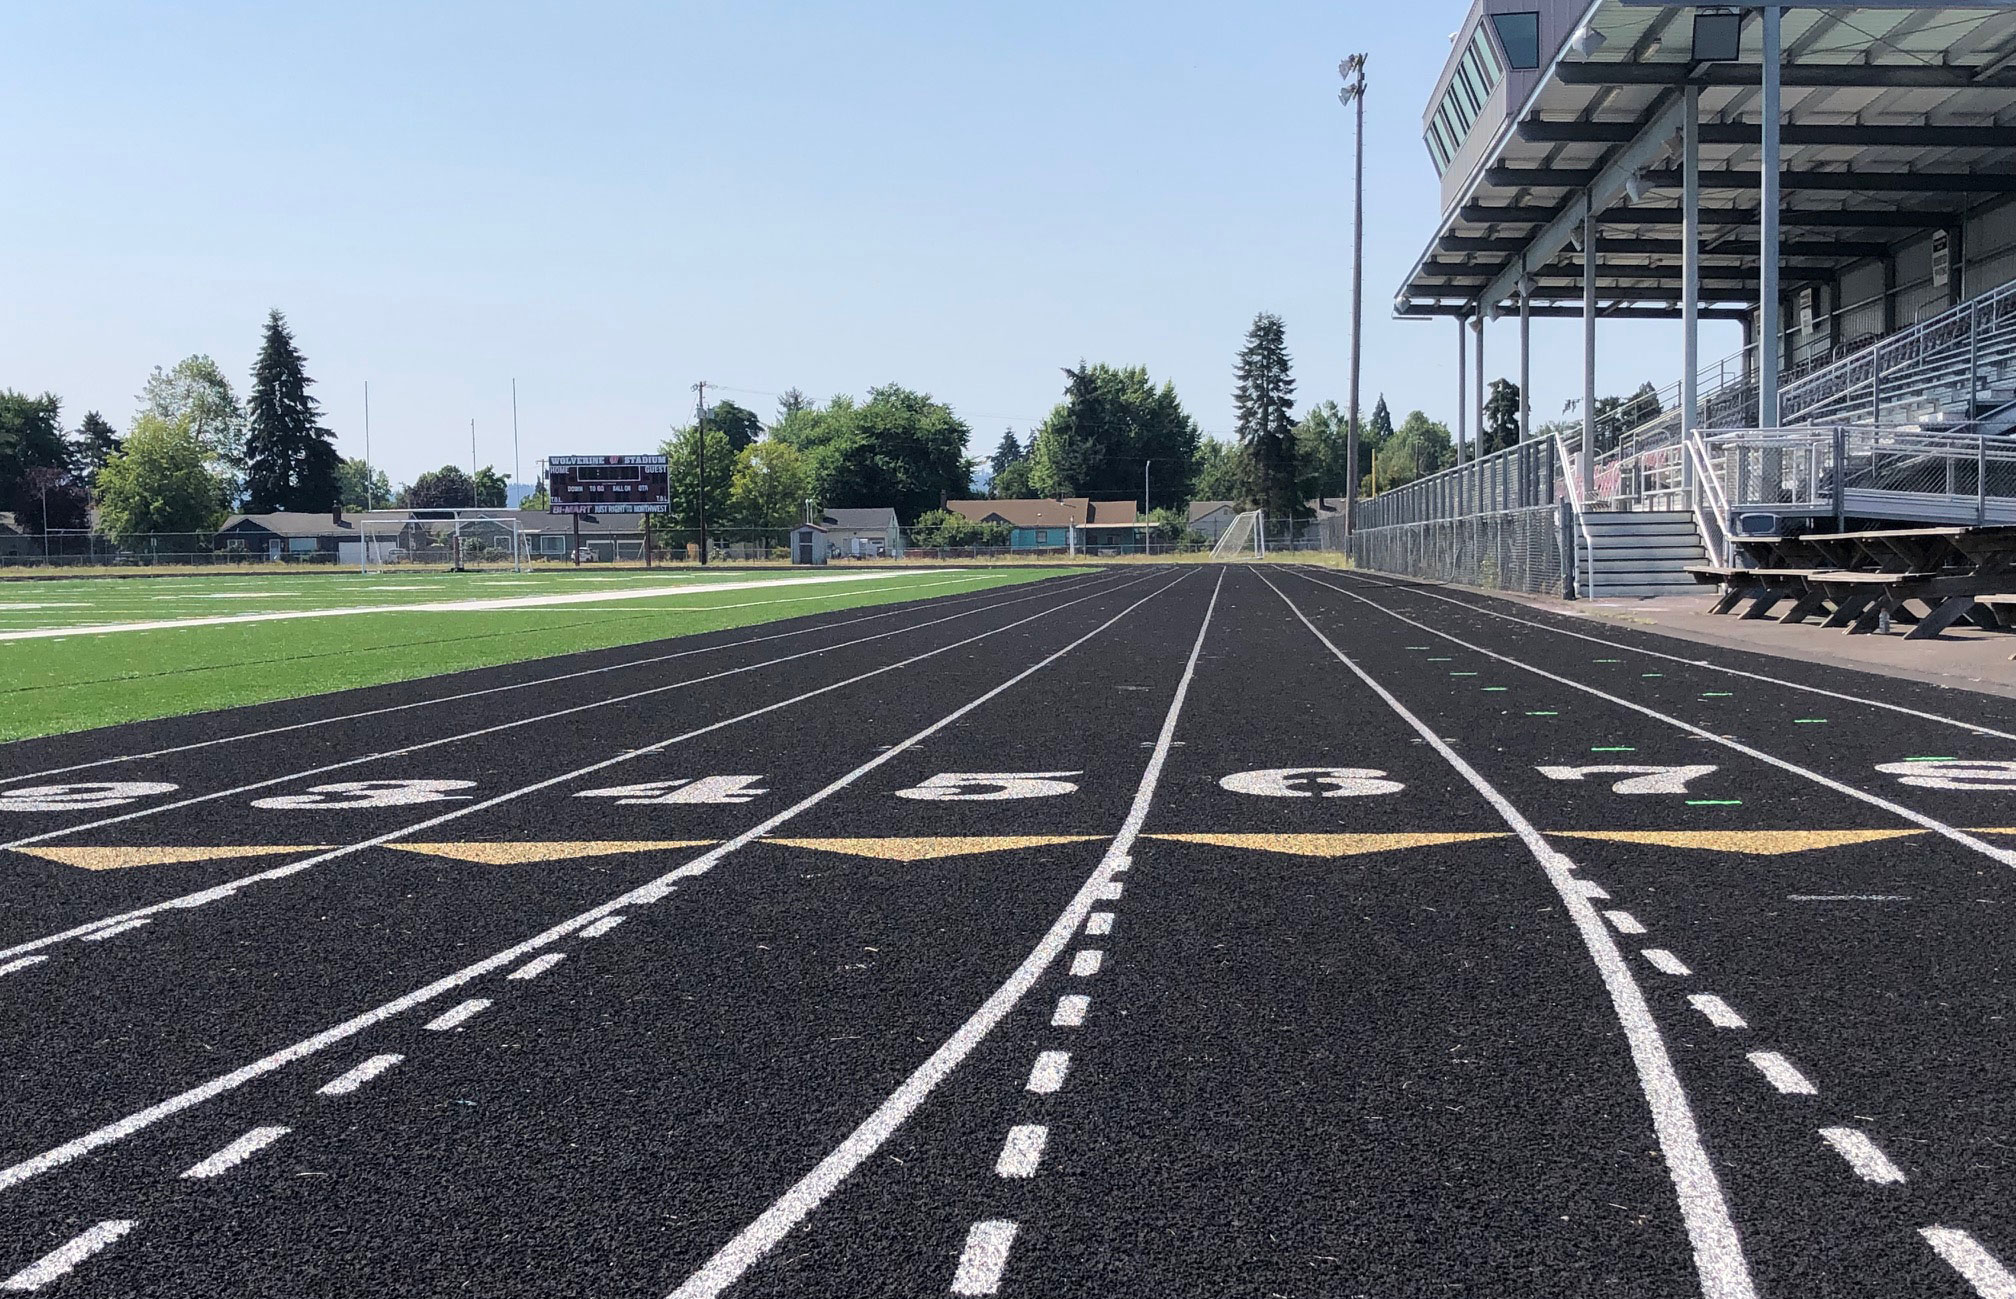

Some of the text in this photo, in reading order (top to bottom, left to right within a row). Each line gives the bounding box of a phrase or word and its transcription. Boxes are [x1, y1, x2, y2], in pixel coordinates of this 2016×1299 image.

[551, 456, 605, 465] WOLVERINE
[624, 456, 666, 464] STADIUM
[645, 465, 667, 473] GUEST
[552, 505, 593, 514] BI-MART
[594, 505, 608, 513] JUST
[608, 505, 625, 513] RIGHT
[633, 505, 667, 513] NORTHWEST
[250, 779, 478, 809] 3
[573, 775, 769, 805] 4
[894, 771, 1083, 800] 5
[1219, 767, 1405, 797] 6
[1535, 765, 1718, 794] 7
